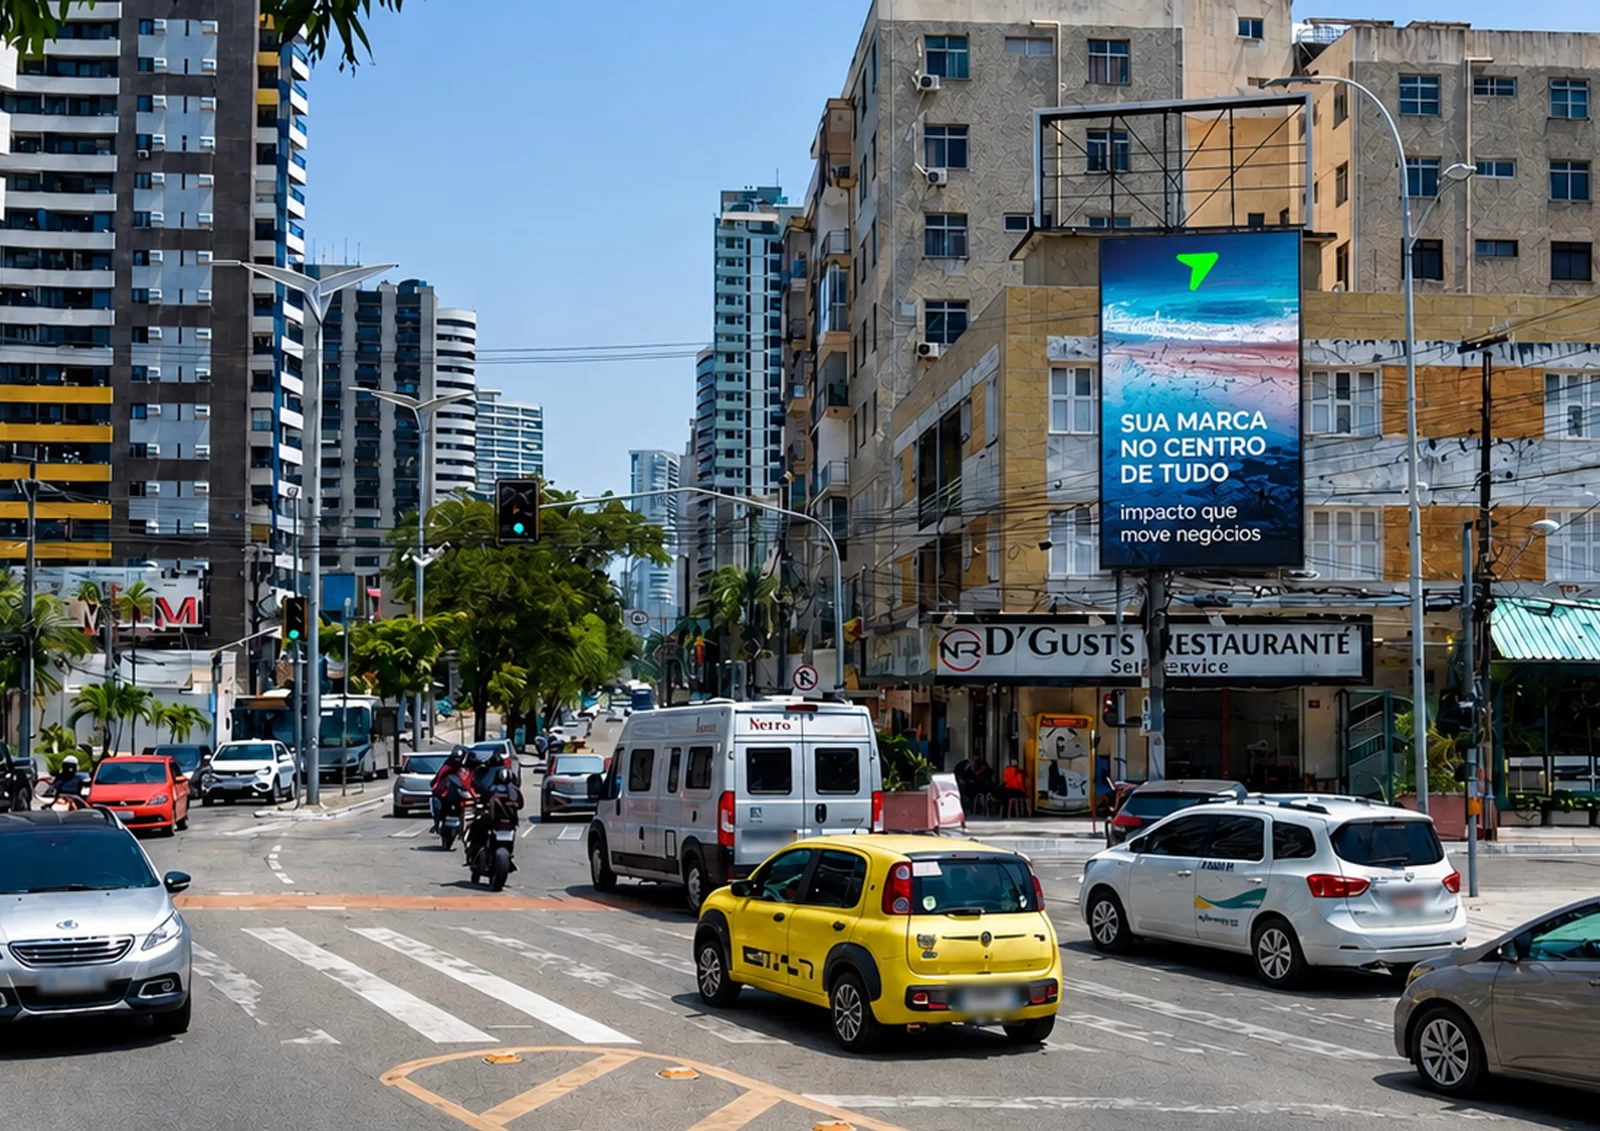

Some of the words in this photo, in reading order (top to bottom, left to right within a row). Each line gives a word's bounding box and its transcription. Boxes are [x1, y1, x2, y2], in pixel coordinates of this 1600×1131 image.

[1121, 412, 1170, 433] SUA
[1177, 410, 1268, 431] MARCA
[1121, 438, 1157, 458] NO
[1164, 436, 1266, 457] CENTRO
[1121, 464, 1153, 484] DE
[1159, 462, 1229, 483] TUDO
[1120, 504, 1197, 524] impacto
[1201, 505, 1238, 523] que
[1121, 529, 1171, 542] move
[1176, 524, 1261, 546] negócios
[1165, 658, 1229, 674] ervice
